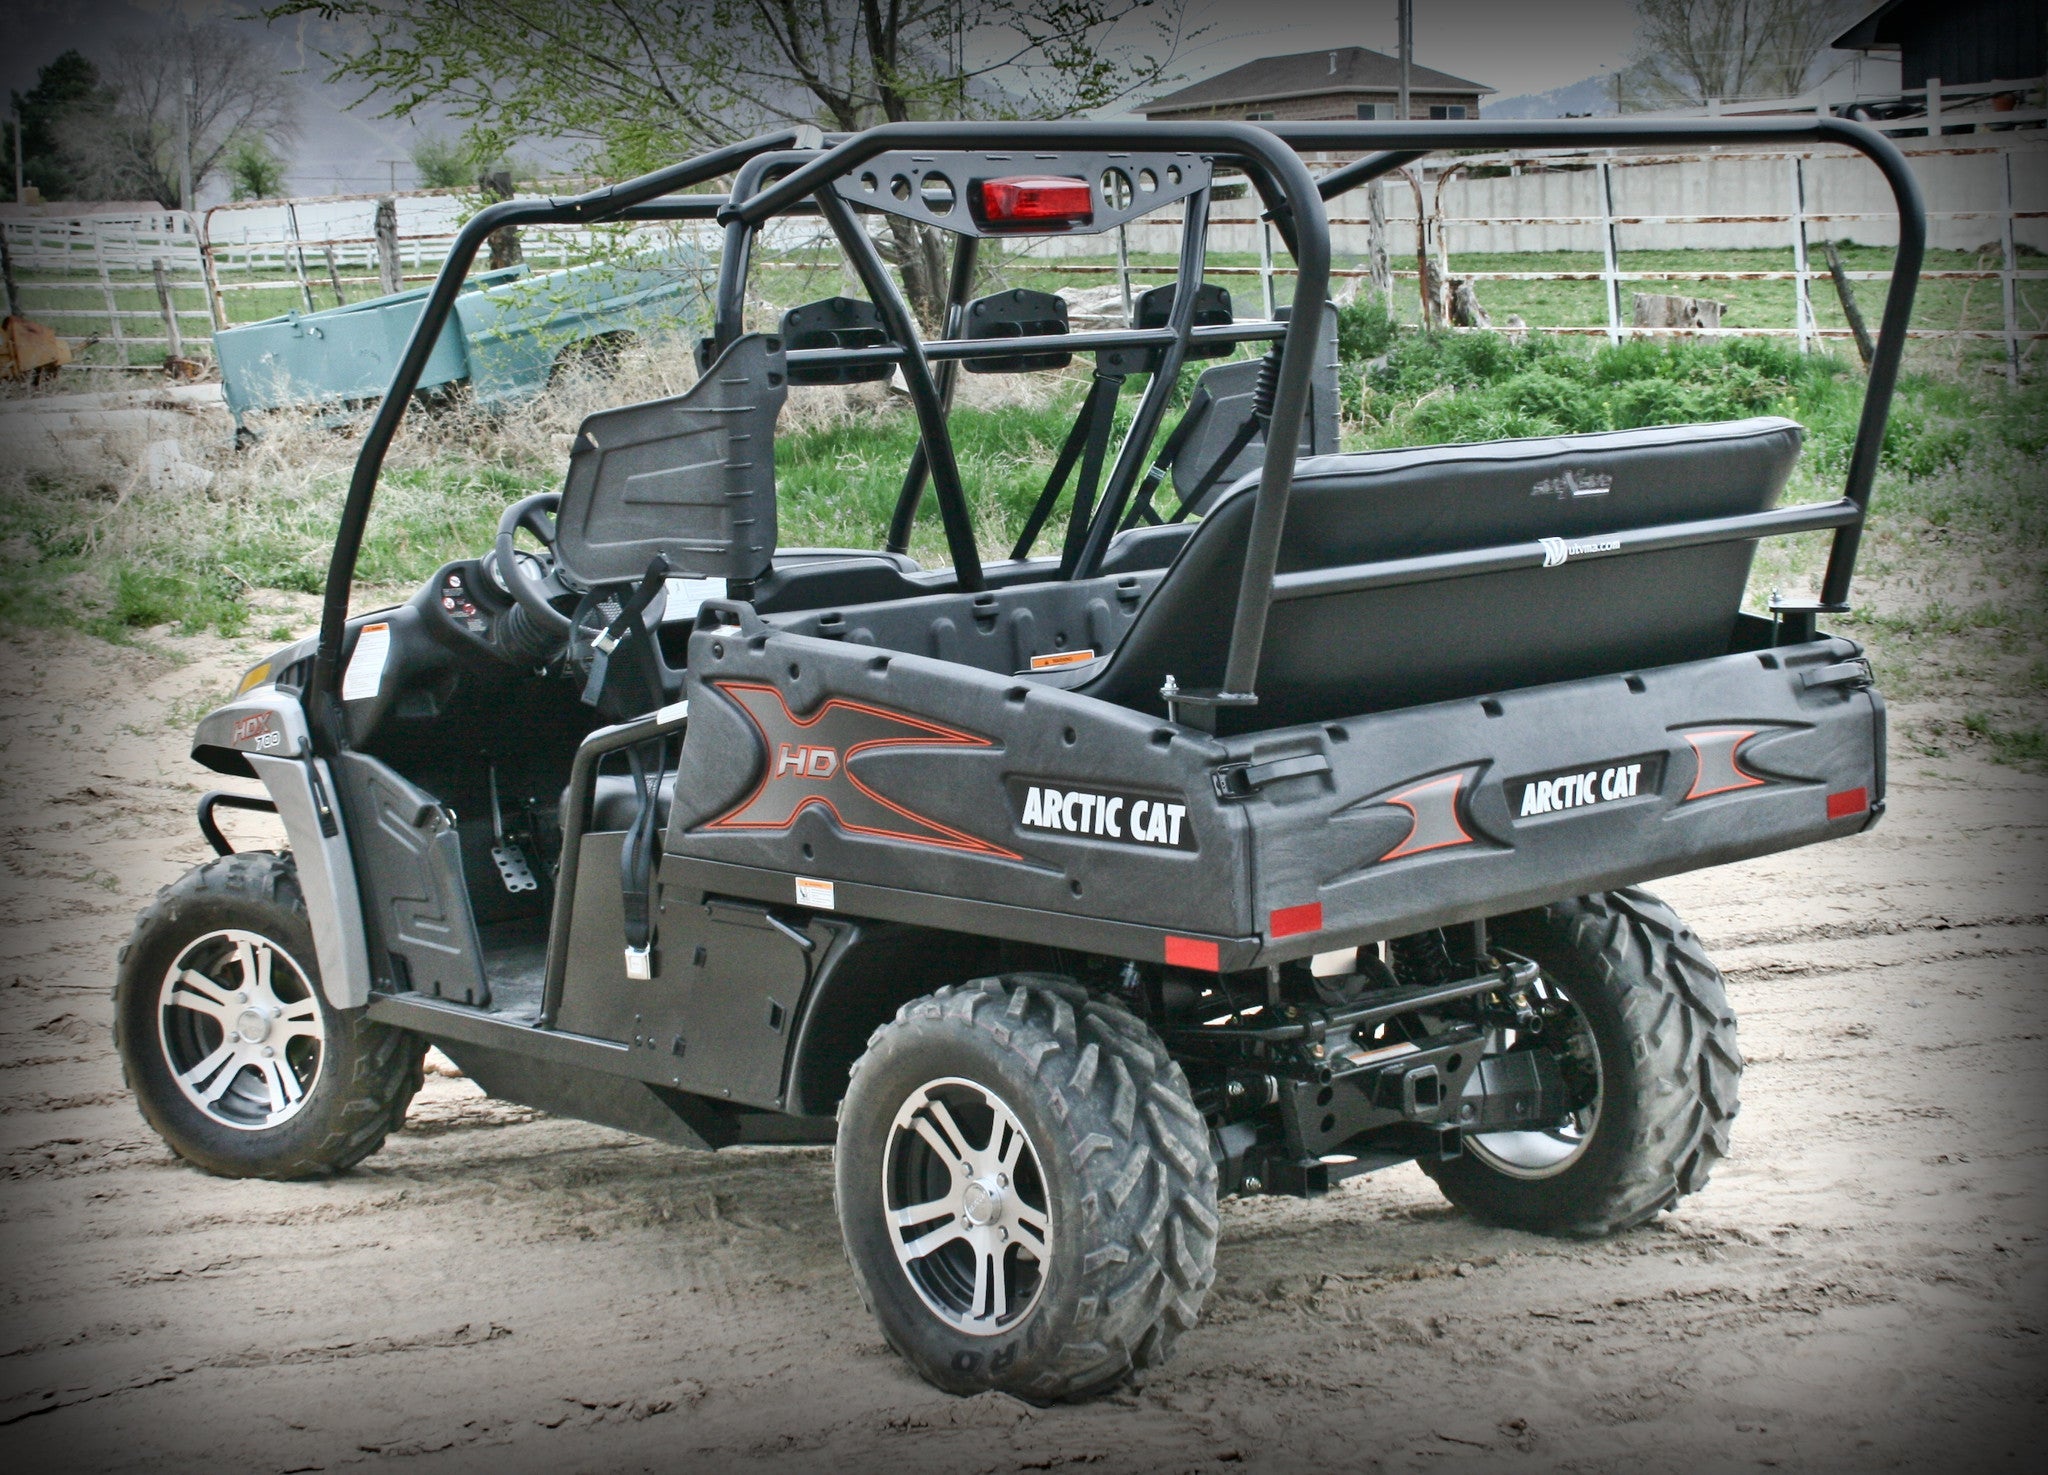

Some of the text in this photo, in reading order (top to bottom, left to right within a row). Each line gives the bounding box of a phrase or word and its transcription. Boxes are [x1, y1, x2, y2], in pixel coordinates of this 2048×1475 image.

[1568, 541, 1621, 555] utvma.com
[231, 709, 274, 747] HDX
[254, 730, 281, 751] 700
[776, 743, 841, 780] HD
[1520, 764, 1641, 816] ARCTIC CAT
[1021, 786, 1186, 845] ARCTIC CAT
